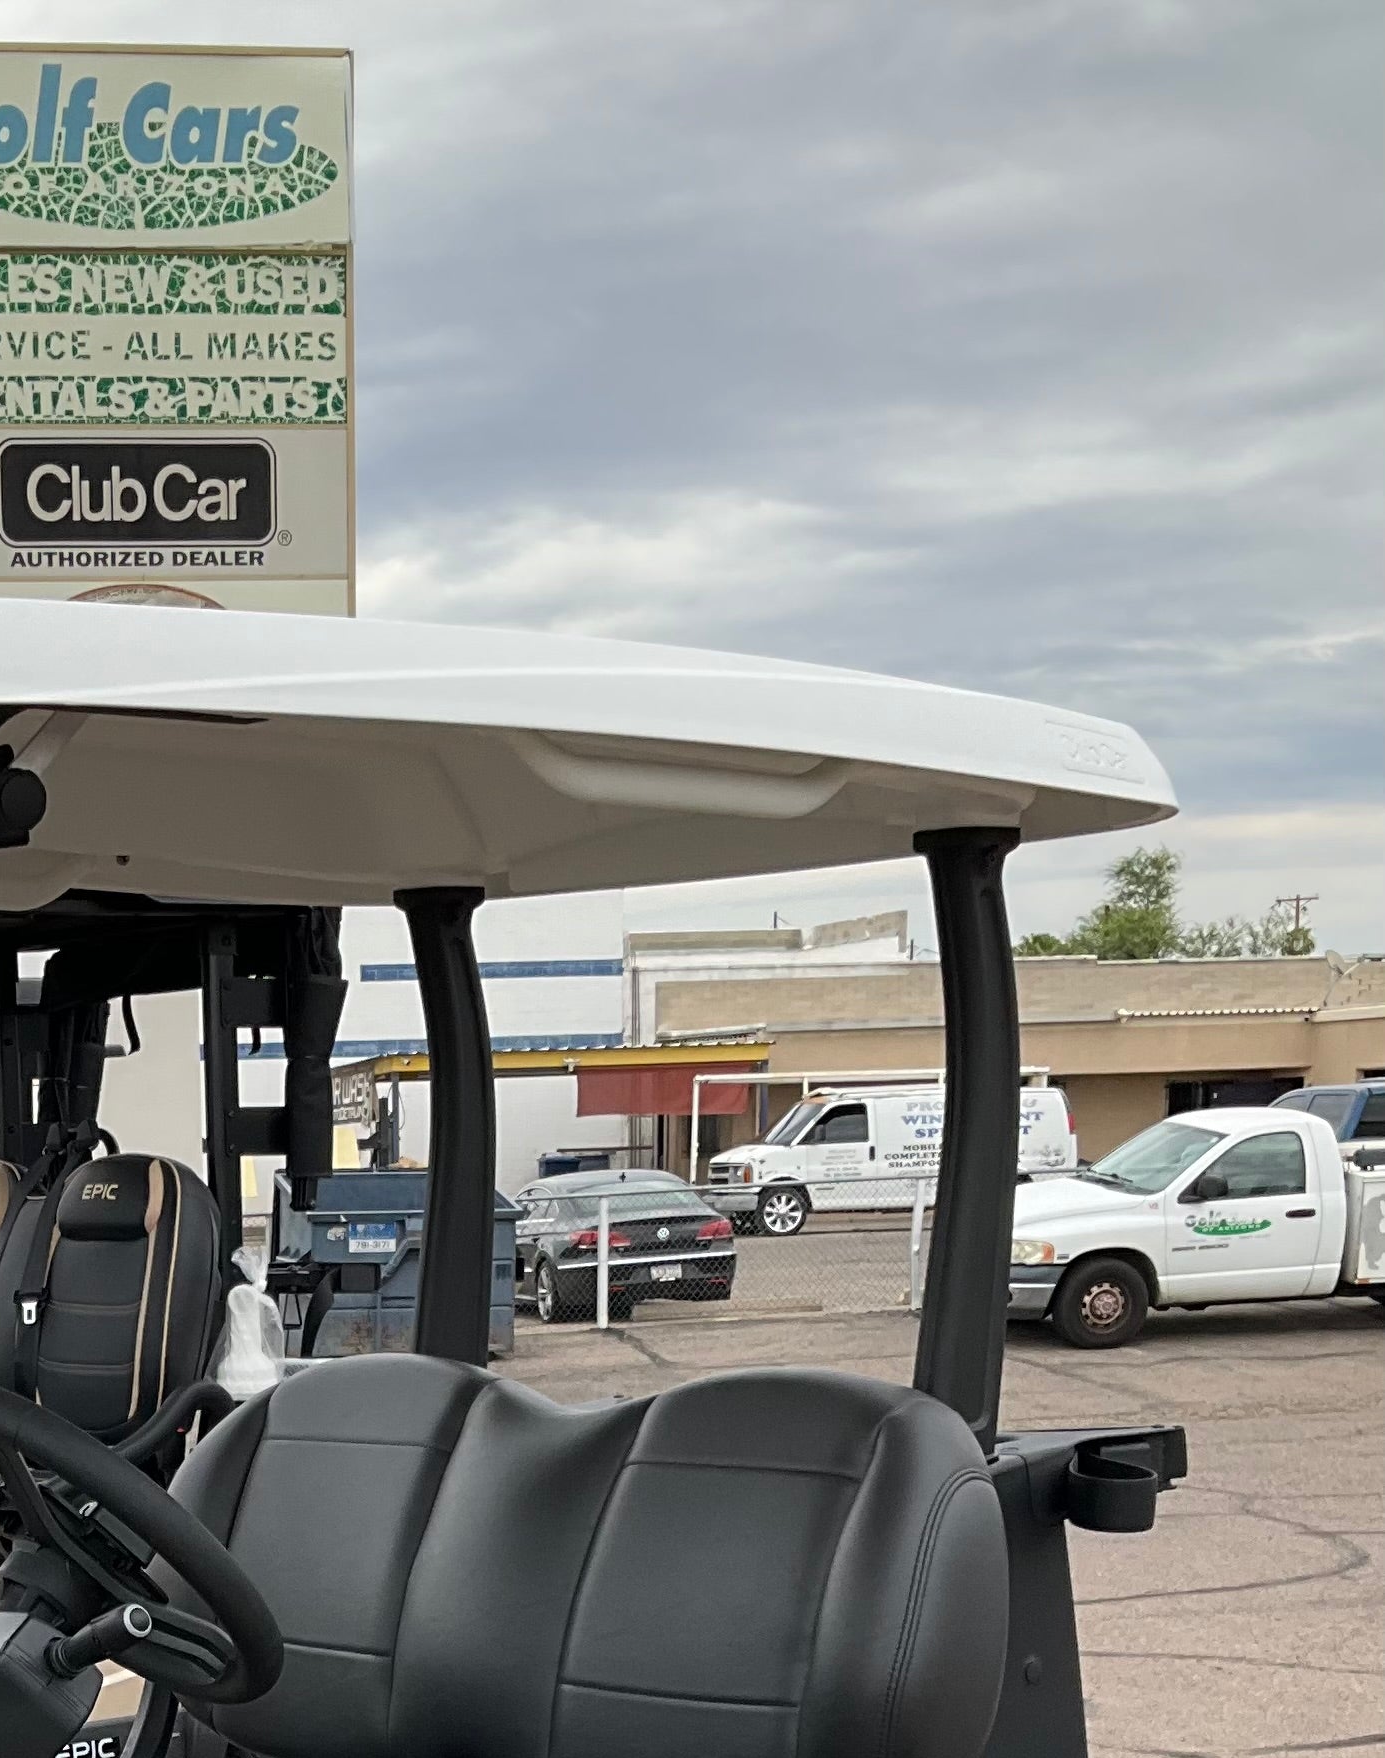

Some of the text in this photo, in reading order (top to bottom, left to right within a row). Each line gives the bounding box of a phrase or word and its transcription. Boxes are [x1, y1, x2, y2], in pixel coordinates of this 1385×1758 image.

[122, 81, 299, 166] Cars
[72, 264, 170, 303] NEW
[180, 268, 214, 302] &
[224, 264, 339, 303] USED
[124, 332, 193, 361] ALL
[207, 332, 337, 361] MAKES
[147, 382, 177, 416] &
[186, 381, 317, 417] PARTS
[26, 463, 247, 522] Club Car
[10, 550, 264, 568] AUTHORIZED DEALER
[81, 1183, 118, 1200] EPIC
